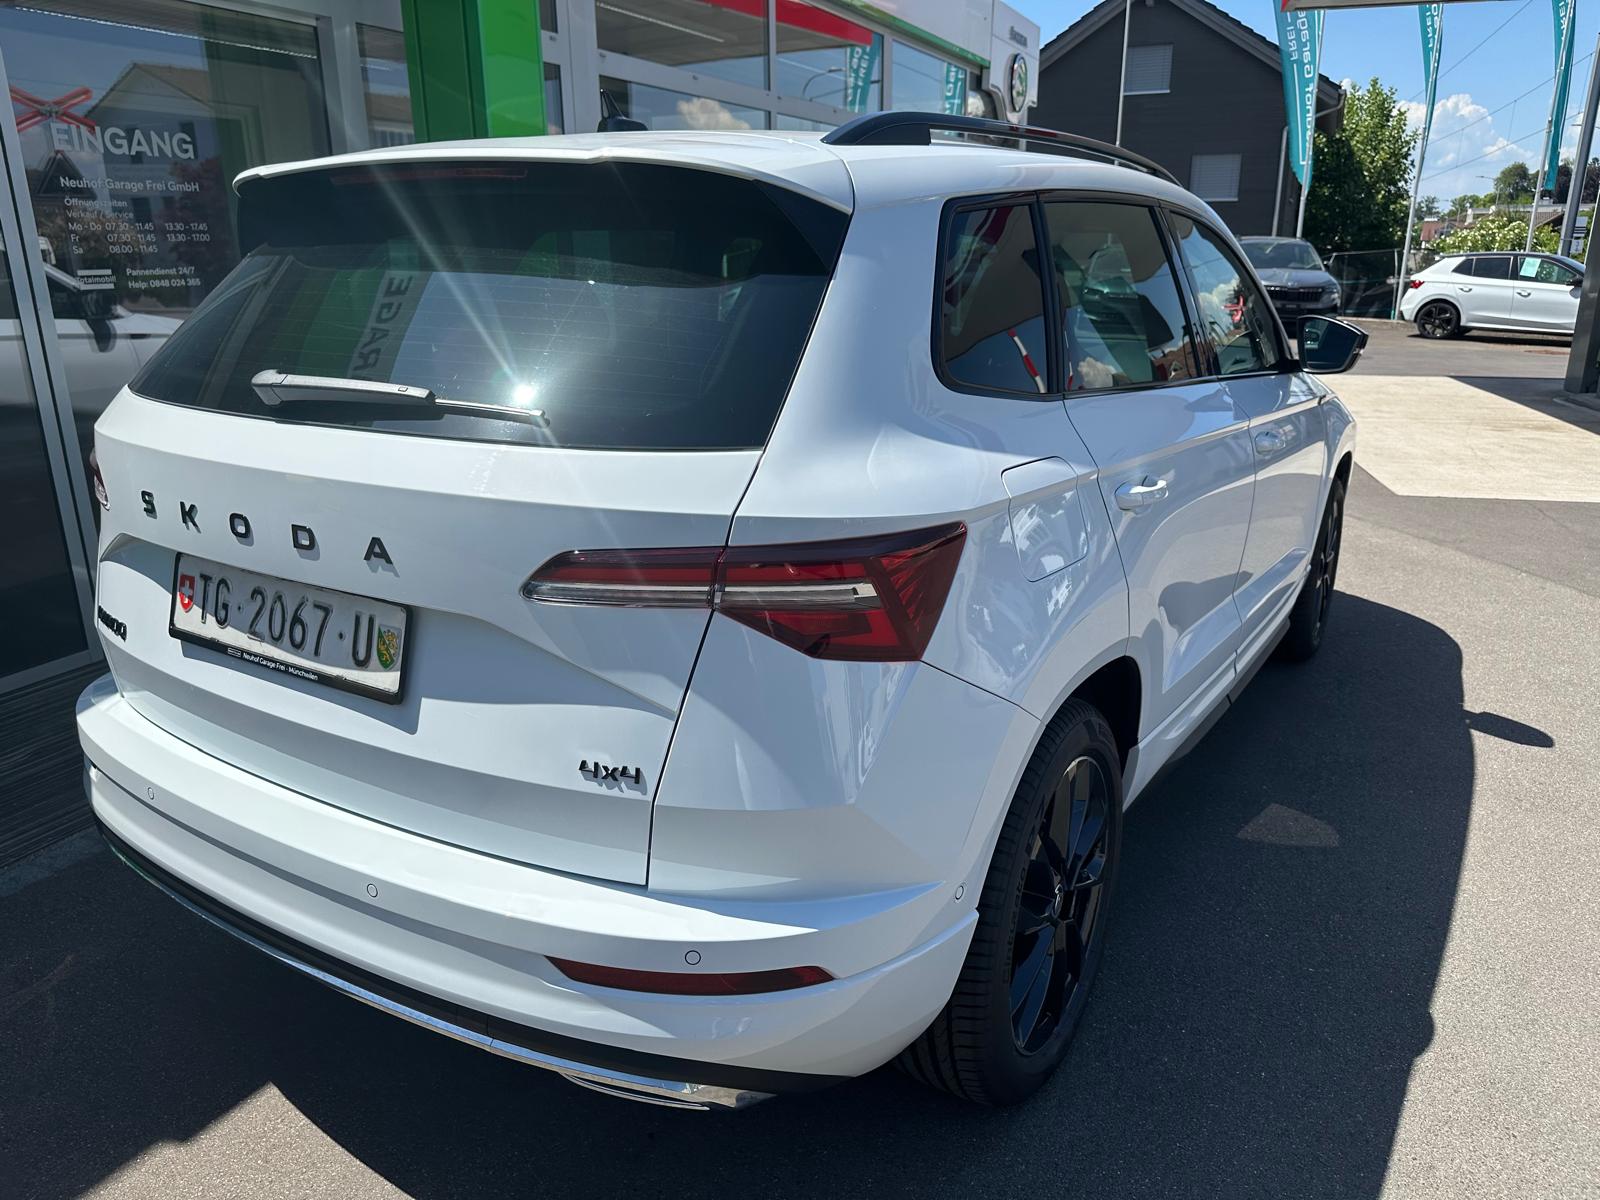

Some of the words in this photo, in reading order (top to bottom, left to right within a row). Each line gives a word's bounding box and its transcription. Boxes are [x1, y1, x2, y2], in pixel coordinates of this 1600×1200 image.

[51, 122, 195, 160] EINGANG
[60, 176, 102, 189] Neuhof
[104, 178, 143, 192] Garage
[146, 180, 166, 191] Frei
[168, 181, 200, 192] GmbH
[68, 222, 83, 231] Mo
[90, 222, 102, 231] Do
[70, 233, 80, 242] Fr
[73, 245, 83, 254] Sa
[126, 267, 177, 277] Pannendienst
[178, 266, 195, 275] 24/7
[141, 490, 393, 565] SKODA
[243, 652, 259, 662] Neuhof
[260, 657, 276, 669] Garage
[579, 759, 641, 785] 4x4
